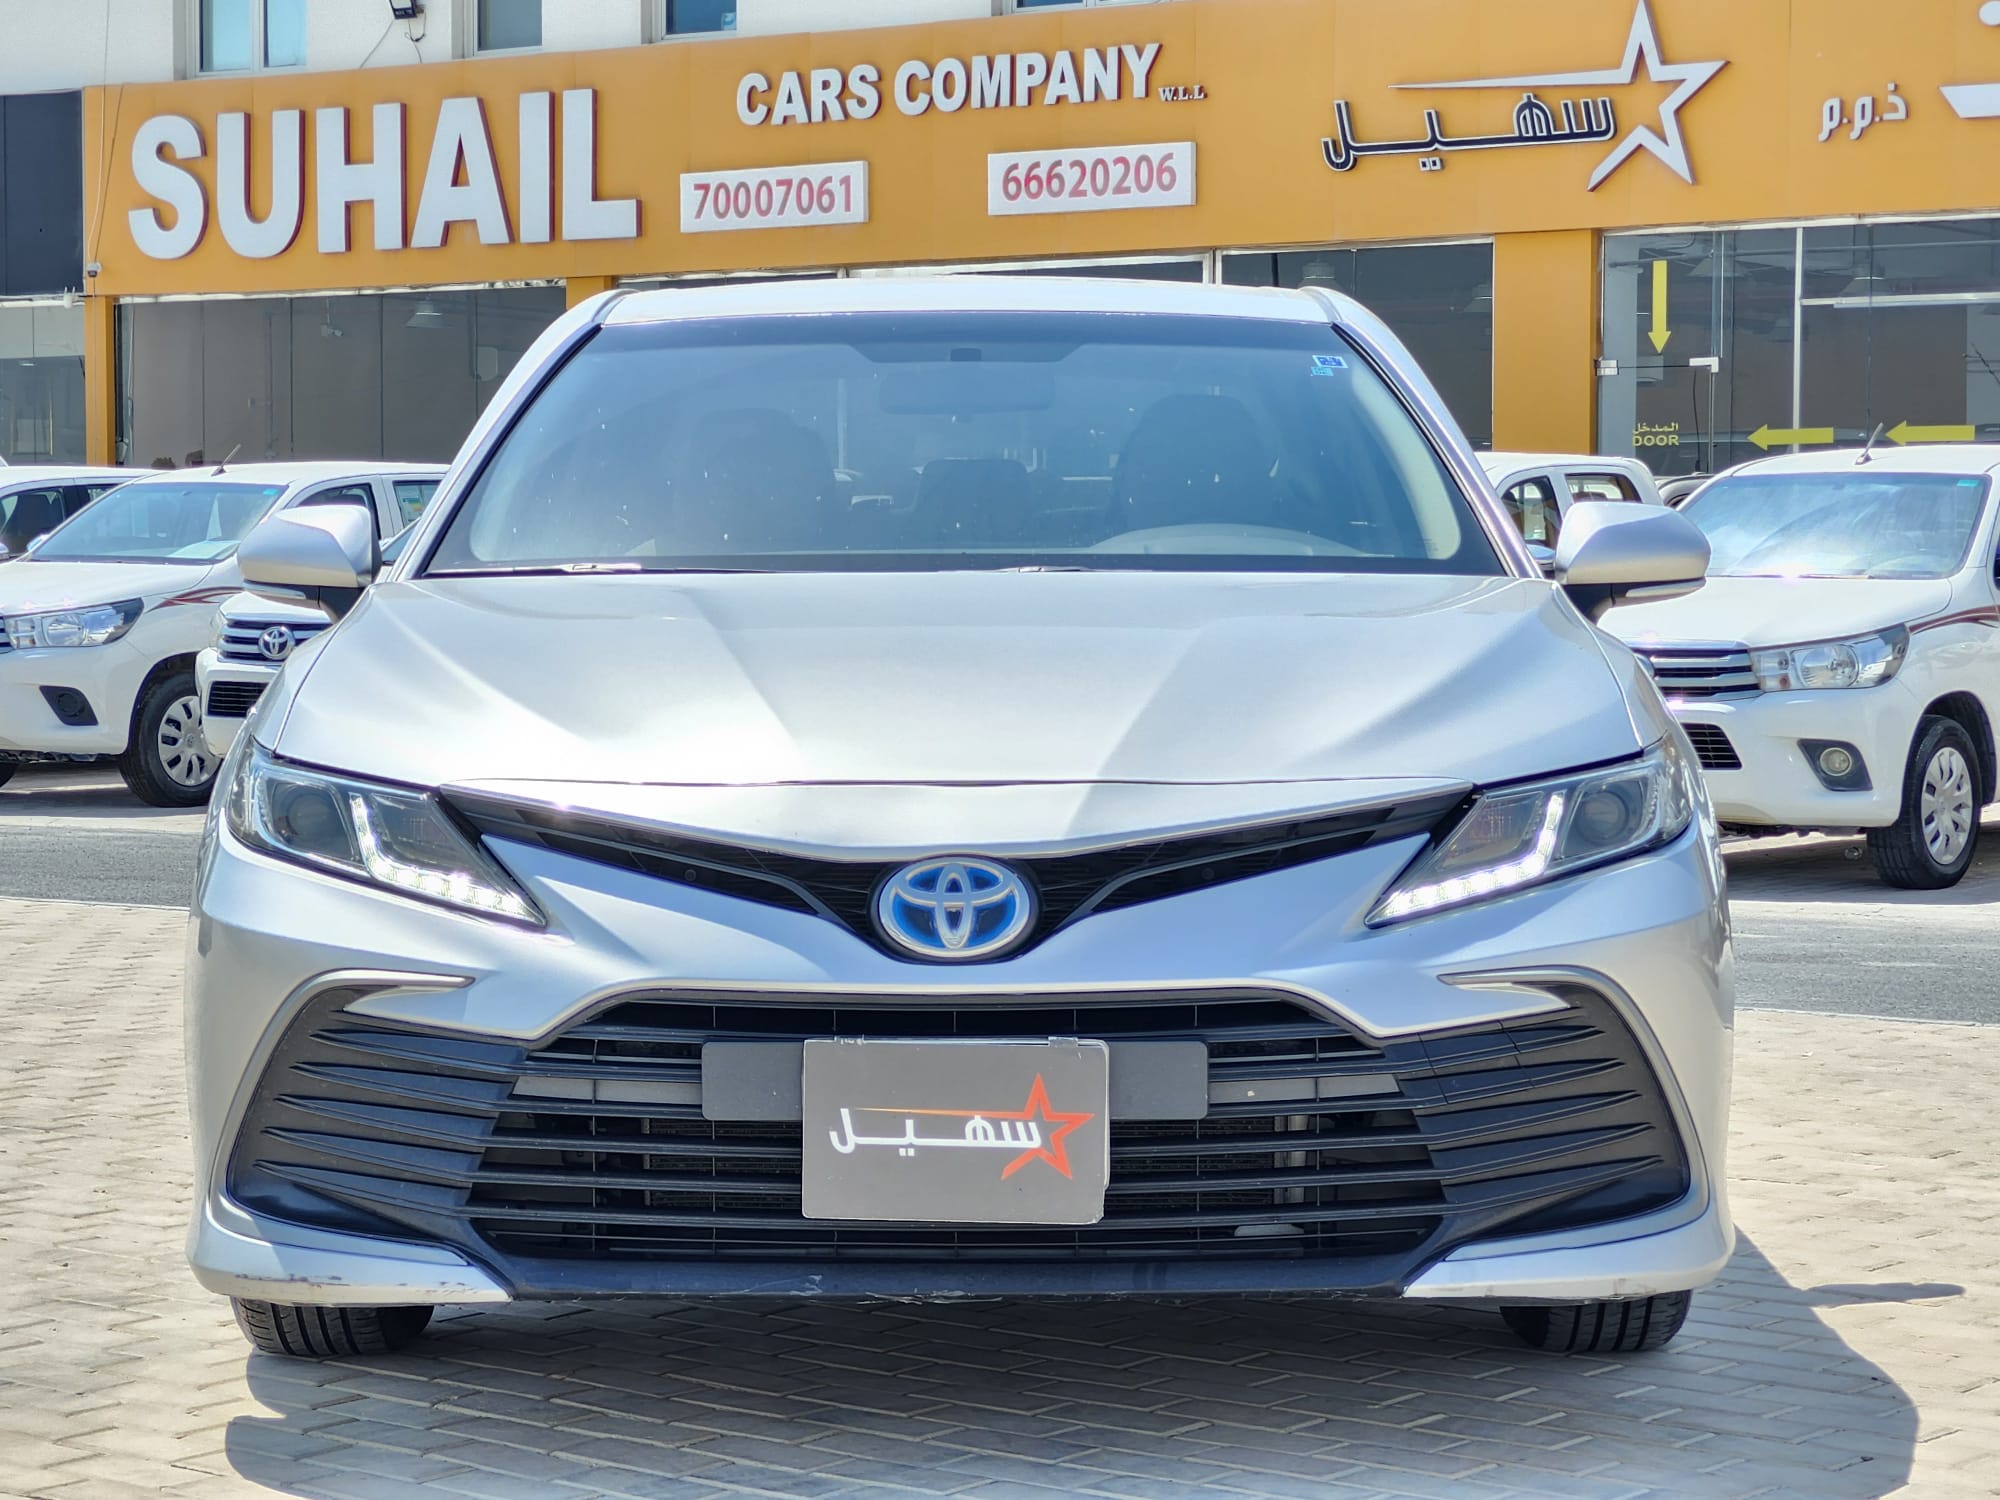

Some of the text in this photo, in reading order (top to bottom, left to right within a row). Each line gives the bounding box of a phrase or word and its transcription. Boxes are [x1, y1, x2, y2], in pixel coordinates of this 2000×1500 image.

[737, 63, 881, 127] CARS
[894, 42, 1162, 117] COMPANY
[1321, 92, 1617, 172] سهيل
[127, 88, 642, 260] SUHAIL
[693, 174, 852, 220] 70007061
[1002, 152, 1177, 202] 66620206
[1632, 434, 1679, 447] DOOR
[1633, 422, 1679, 434] المدخل
[829, 1108, 1042, 1157] سهيل
